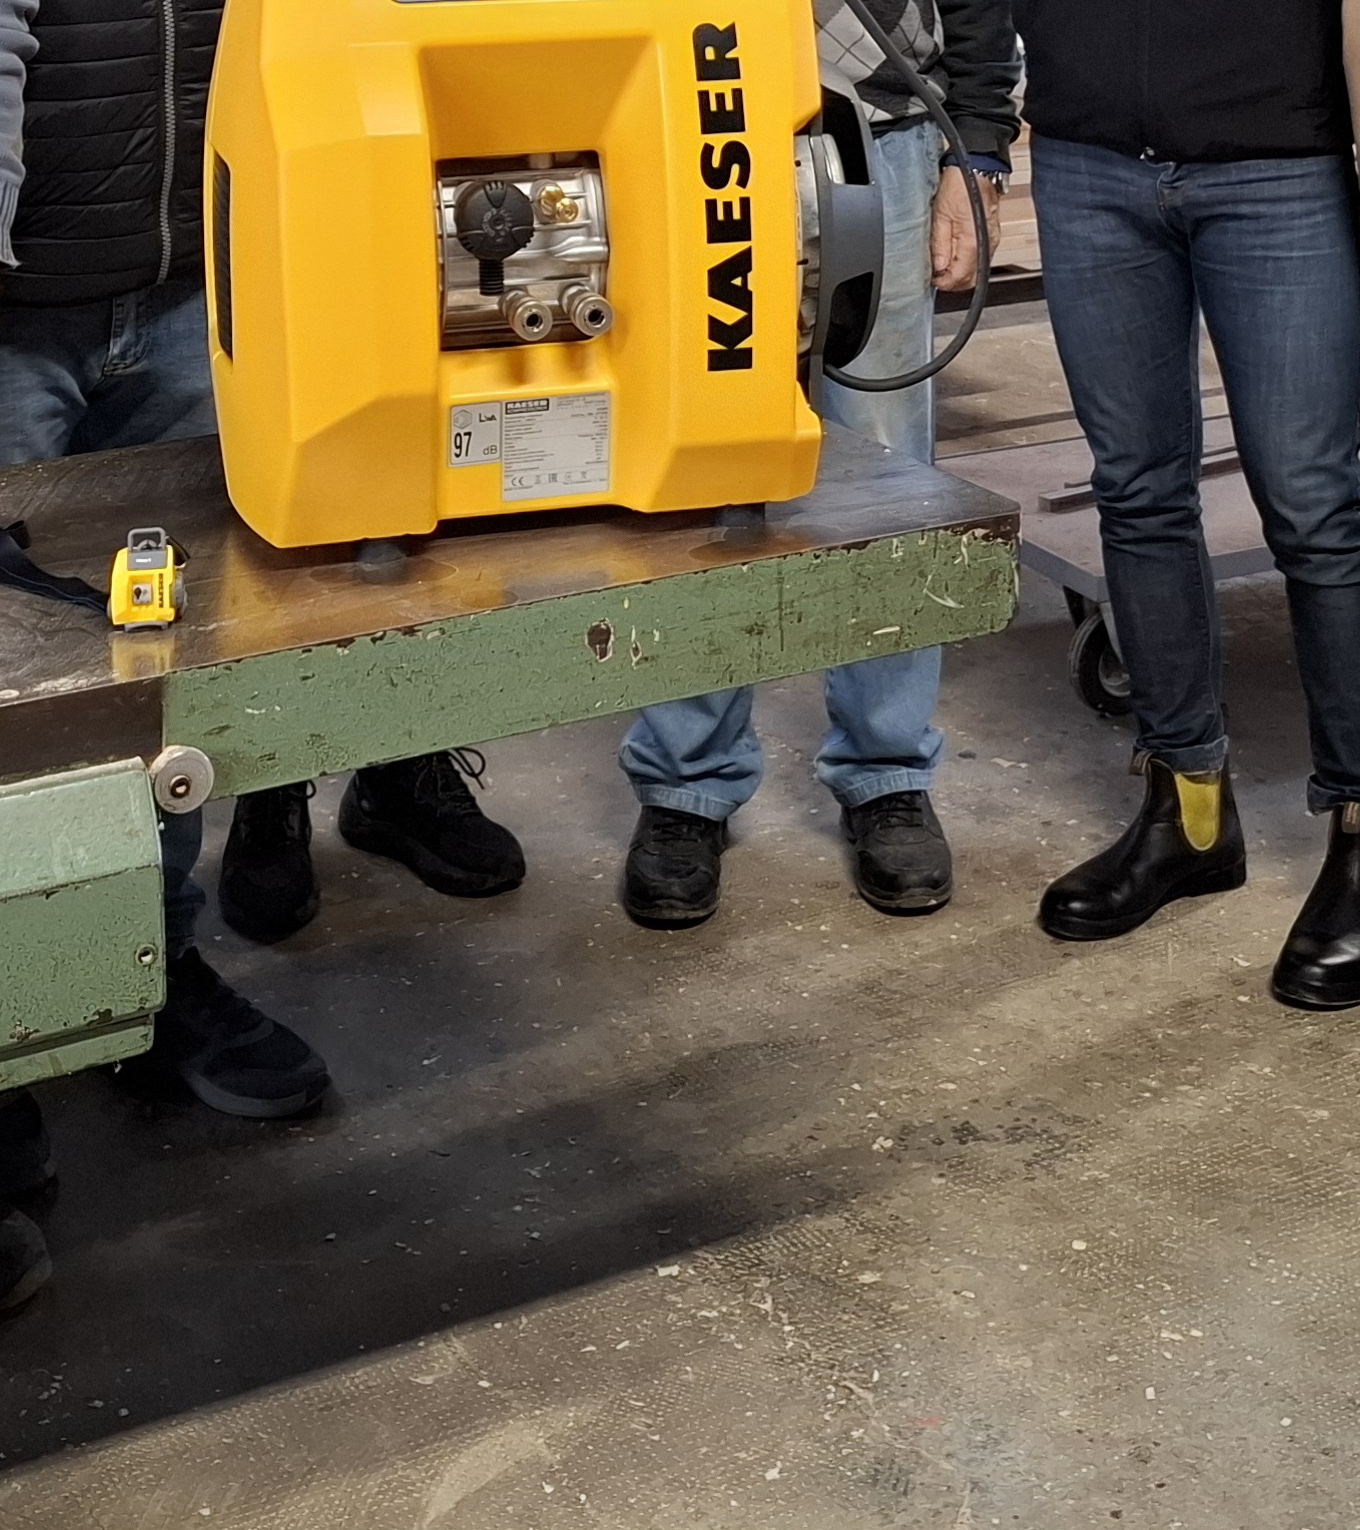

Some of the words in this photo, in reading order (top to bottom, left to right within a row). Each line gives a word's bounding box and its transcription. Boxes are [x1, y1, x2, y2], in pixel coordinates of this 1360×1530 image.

[692, 21, 753, 372] KAESER
[454, 431, 472, 458] 97
[483, 444, 498, 455] dB
